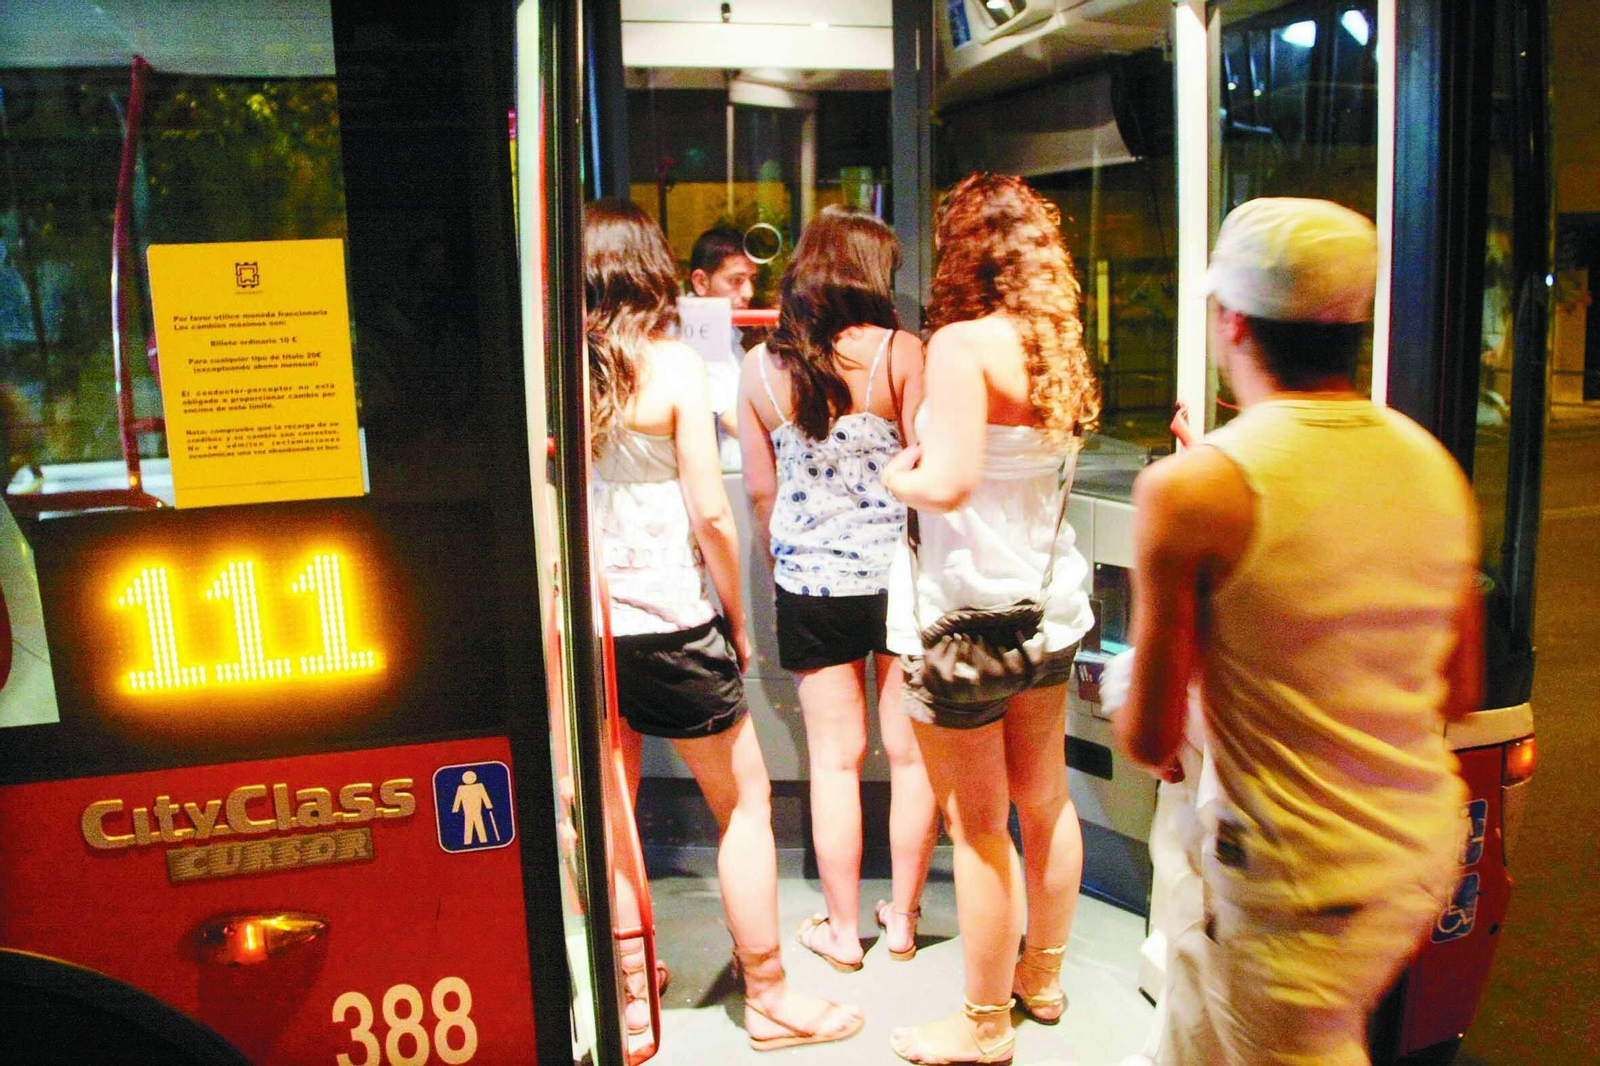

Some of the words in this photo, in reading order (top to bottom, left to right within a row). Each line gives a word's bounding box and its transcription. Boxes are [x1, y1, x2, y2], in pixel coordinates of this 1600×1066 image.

[173, 315, 188, 323] Por
[189, 313, 212, 322] favor
[213, 312, 240, 320] utilice
[242, 311, 275, 319] moneda
[277, 308, 328, 318] fraccionaria
[191, 322, 227, 330] cambios
[699, 323, 710, 340] €
[210, 339, 237, 347] Billete
[239, 337, 277, 346] ordinario
[279, 336, 290, 344] 10
[188, 357, 208, 365] Para
[209, 355, 249, 366] cualquier
[251, 354, 269, 363] tipo
[306, 351, 322, 359] 20€
[193, 364, 251, 374] (exceptuando
[253, 362, 278, 370] abono
[280, 361, 319, 369] mensual)
[196, 384, 293, 396] conductor-perceptor
[182, 397, 219, 406] obligado
[230, 393, 285, 404] proporcionar
[288, 391, 319, 399] cambio
[322, 391, 336, 399] por
[183, 406, 214, 414] encima
[210, 426, 255, 436] compruebe
[257, 424, 273, 433] que
[284, 422, 315, 431] recarga
[247, 431, 277, 439] cambio
[226, 441, 264, 449] admiten
[271, 437, 341, 447] reclamaciones
[268, 446, 315, 454] abandonado
[116, 552, 376, 692] 111
[81, 777, 417, 852] CityClass
[175, 829, 373, 878] CURSOR
[332, 976, 478, 1066] 388
